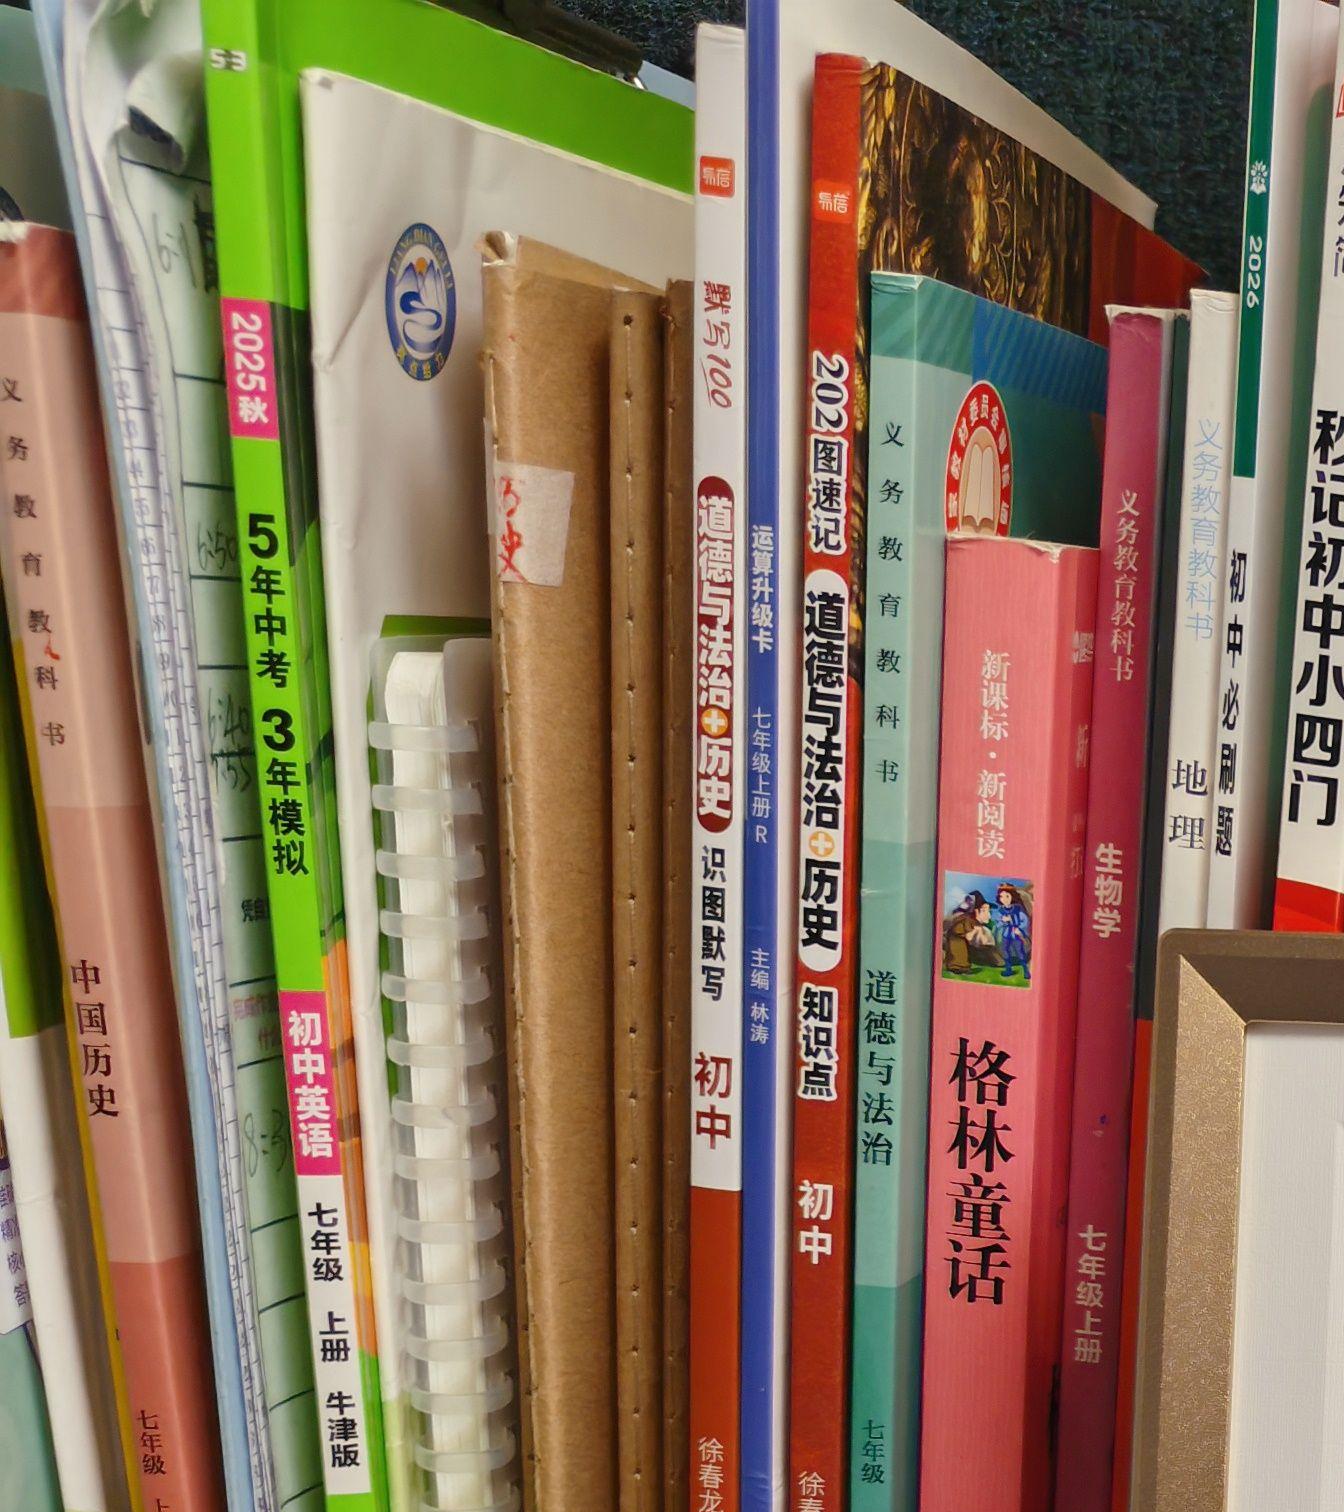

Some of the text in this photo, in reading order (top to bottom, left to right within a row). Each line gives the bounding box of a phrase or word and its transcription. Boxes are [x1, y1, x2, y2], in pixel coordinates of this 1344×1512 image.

[210, 48, 247, 71] 53
[1246, 235, 1263, 309] 2026
[231, 312, 269, 425] 2025秋
[703, 280, 733, 409] 默写100
[811, 353, 847, 554] 202图速记
[1, 378, 66, 747] 义务教育教科书
[752, 525, 774, 654] 运算升级卡
[1107, 489, 1141, 682] 义务教育教科书
[1186, 419, 1222, 641] 义务教育教科书
[875, 421, 904, 783] 义务教育教科书
[248, 512, 309, 877] 5年中考 3年模拟
[1215, 549, 1247, 857] 初中必刷题
[751, 706, 772, 843] 七年级上册 R
[1168, 759, 1208, 850] 地理
[701, 845, 726, 1001] 识图默写
[1092, 842, 1124, 938] 生物学
[70, 957, 119, 1117] 中国历史
[750, 947, 770, 1045] 主编 林涛
[802, 986, 836, 1097] 知识点
[288, 1009, 334, 1159] 初中英语
[694, 1050, 732, 1151] 初中
[861, 969, 898, 1167] 道德与法治
[798, 1179, 833, 1266] 初中
[942, 1036, 1017, 1306] 格林童话
[308, 1202, 360, 1468] 七年级 上册 牛津版
[1074, 1224, 1108, 1364] 七年级上册
[136, 1408, 166, 1476] 七年级
[860, 1419, 885, 1485] 七年级
